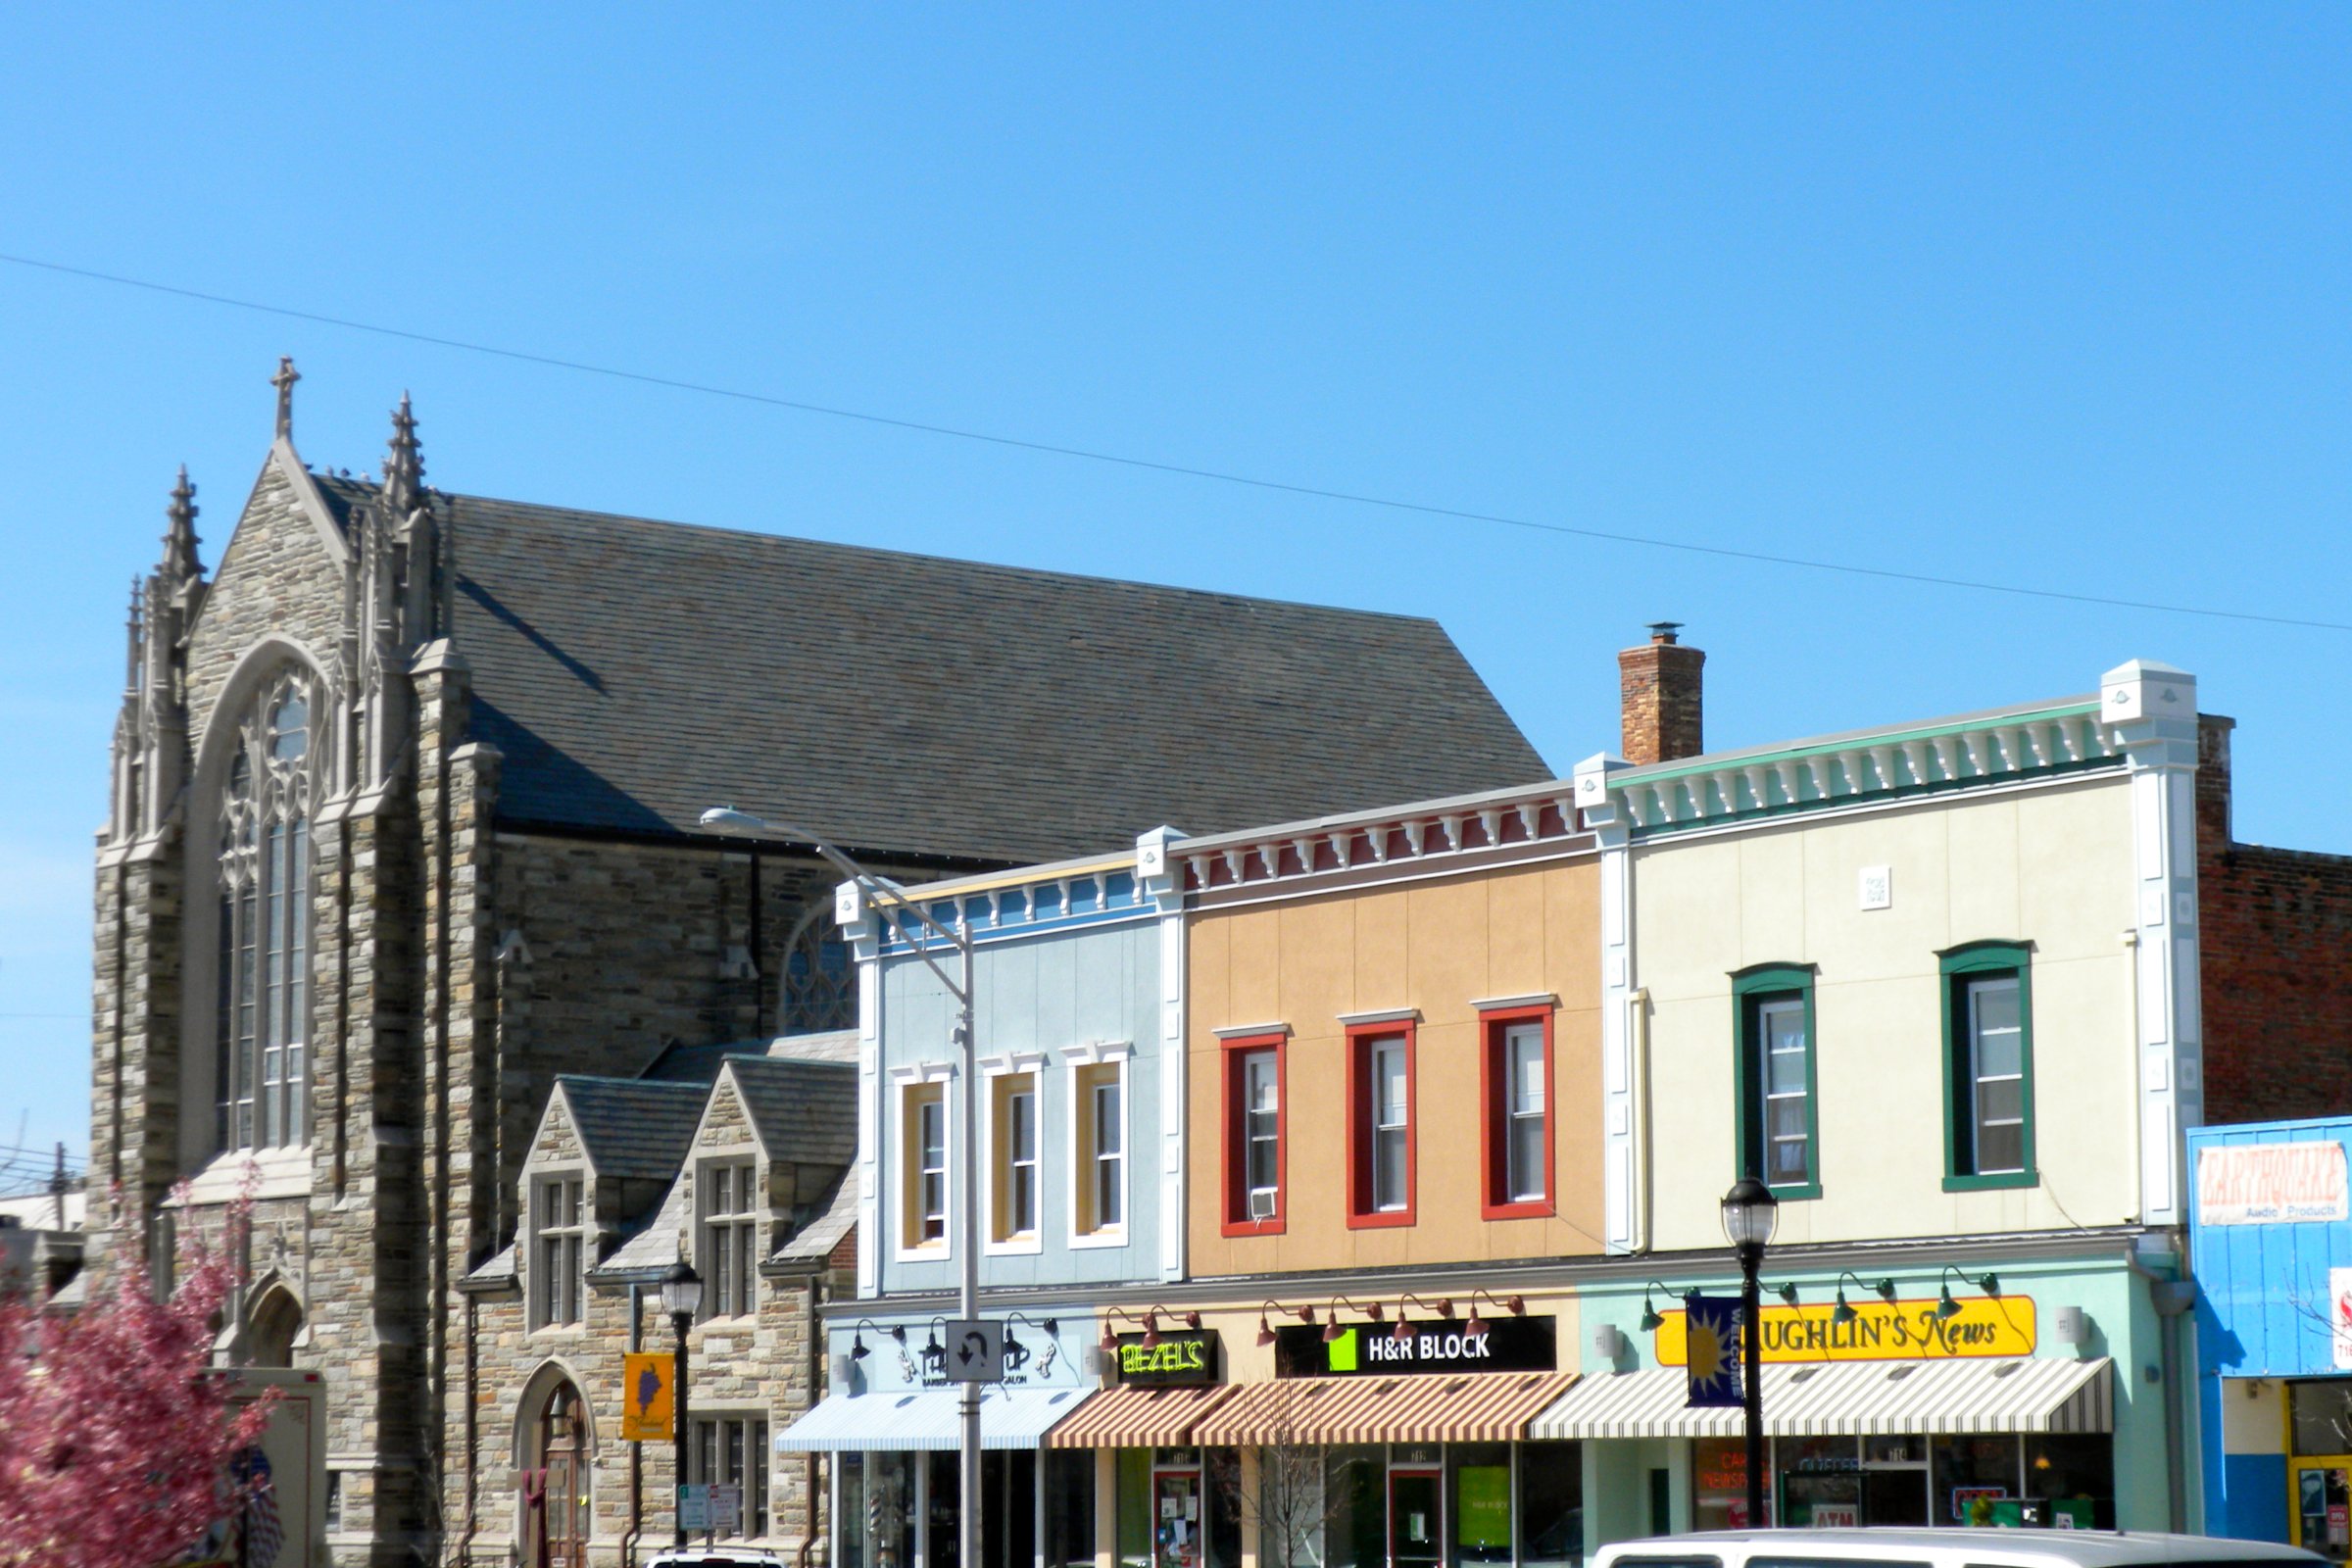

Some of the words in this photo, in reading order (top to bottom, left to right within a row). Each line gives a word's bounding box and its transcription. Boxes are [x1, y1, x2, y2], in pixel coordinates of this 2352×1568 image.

[2202, 1147, 2343, 1208] EARTHQUAKE
[2246, 1206, 2278, 1218] Audio
[2287, 1204, 2337, 1217] Products
[1369, 1335, 1413, 1361] H&R
[1419, 1333, 1491, 1359] BLOCK
[1919, 1309, 1997, 1355] News
[1120, 1341, 1204, 1373] BEZEL'S
[1730, 1307, 1743, 1397] WELCOME
[1817, 1511, 1854, 1528] ATM
